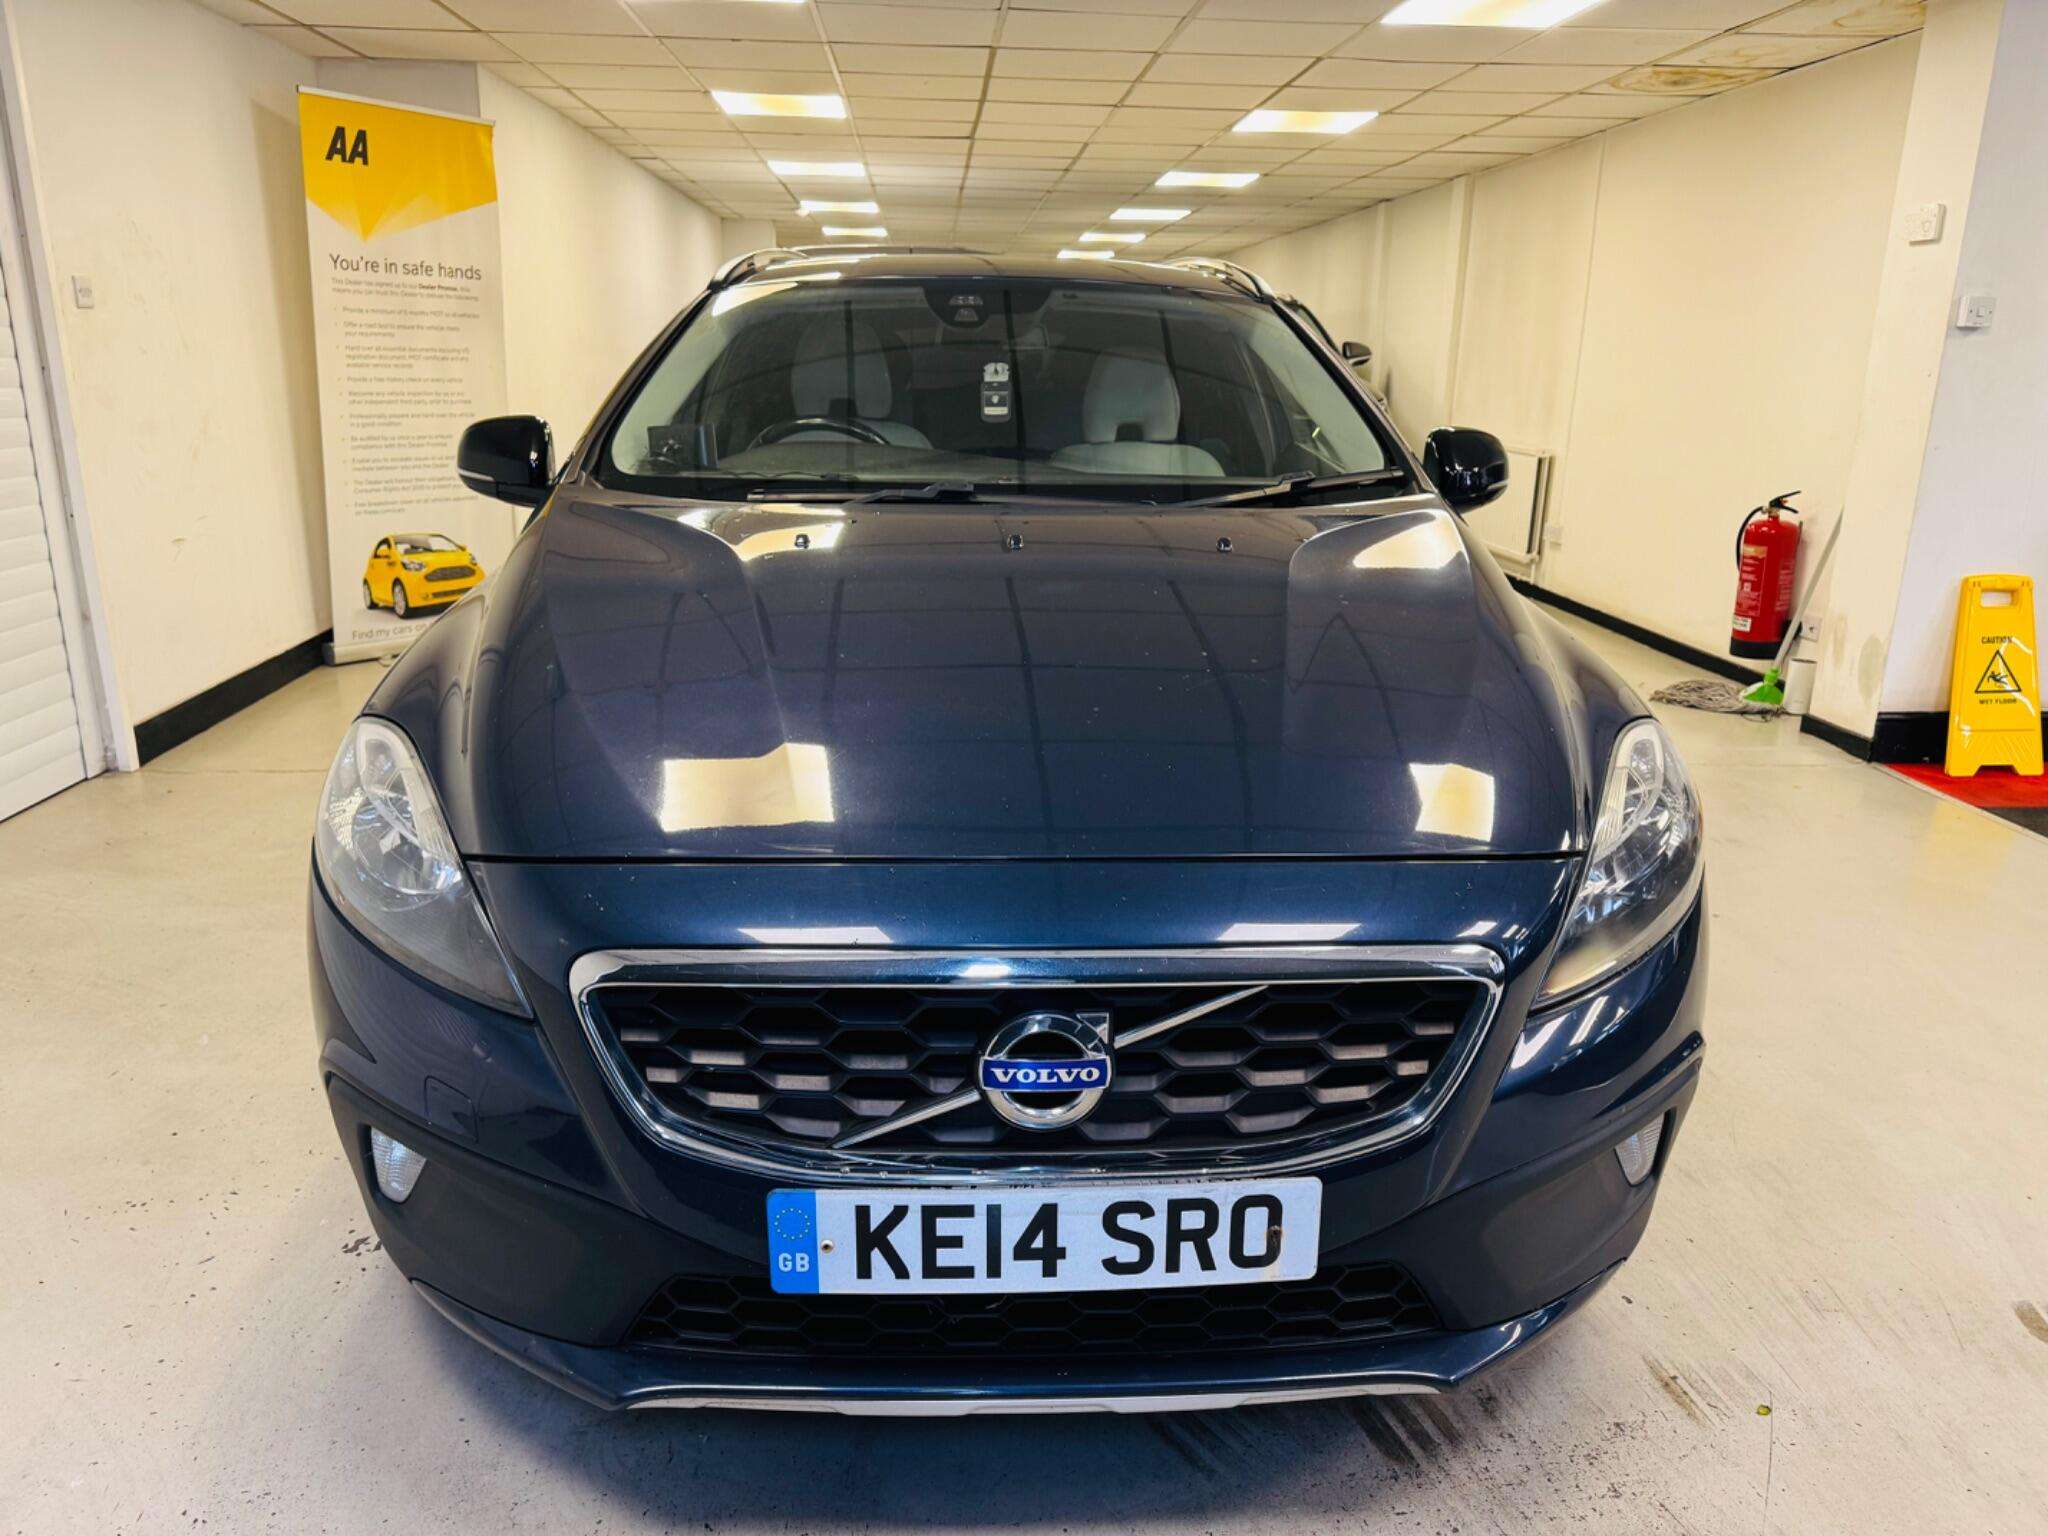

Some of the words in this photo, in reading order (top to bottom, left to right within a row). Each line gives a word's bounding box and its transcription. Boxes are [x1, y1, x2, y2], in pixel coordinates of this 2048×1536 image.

[325, 126, 369, 165] AA
[329, 254, 380, 273] You're
[384, 258, 398, 274] in
[402, 260, 433, 276] safe
[438, 262, 482, 280] hands
[352, 629, 373, 640] Find
[377, 628, 390, 637] my
[393, 625, 413, 635] cars
[1981, 635, 2013, 644] CAUTION
[991, 1066, 1101, 1084] VOLVO
[854, 1203, 1067, 1281] KE14
[1100, 1194, 1284, 1276] SRO
[778, 1252, 810, 1274] GB
